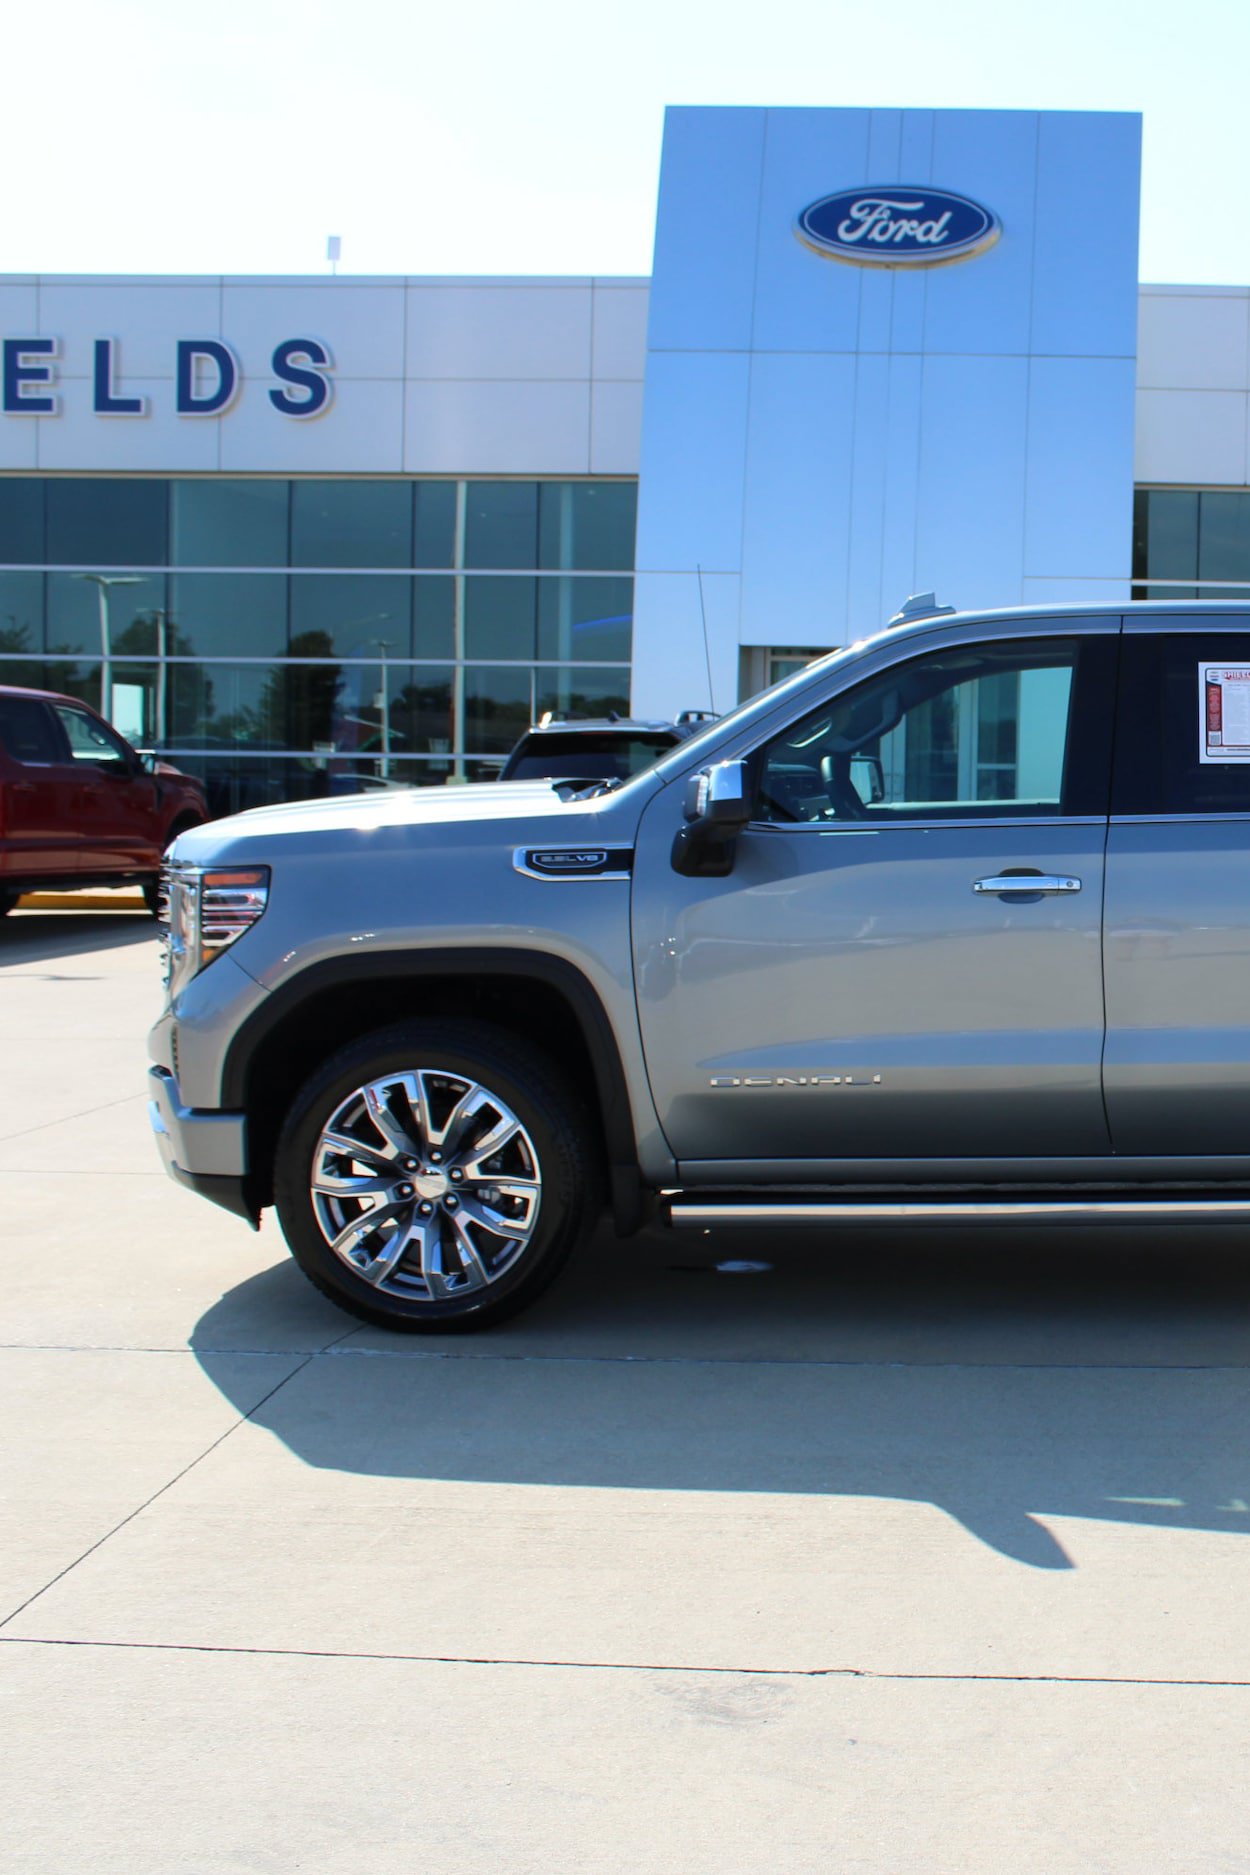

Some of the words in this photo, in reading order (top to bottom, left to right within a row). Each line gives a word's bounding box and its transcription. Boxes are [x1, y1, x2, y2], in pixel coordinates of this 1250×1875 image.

[837, 198, 952, 243] Ford
[1, 337, 333, 418] ELDS
[710, 1072, 880, 1088] DENALI
